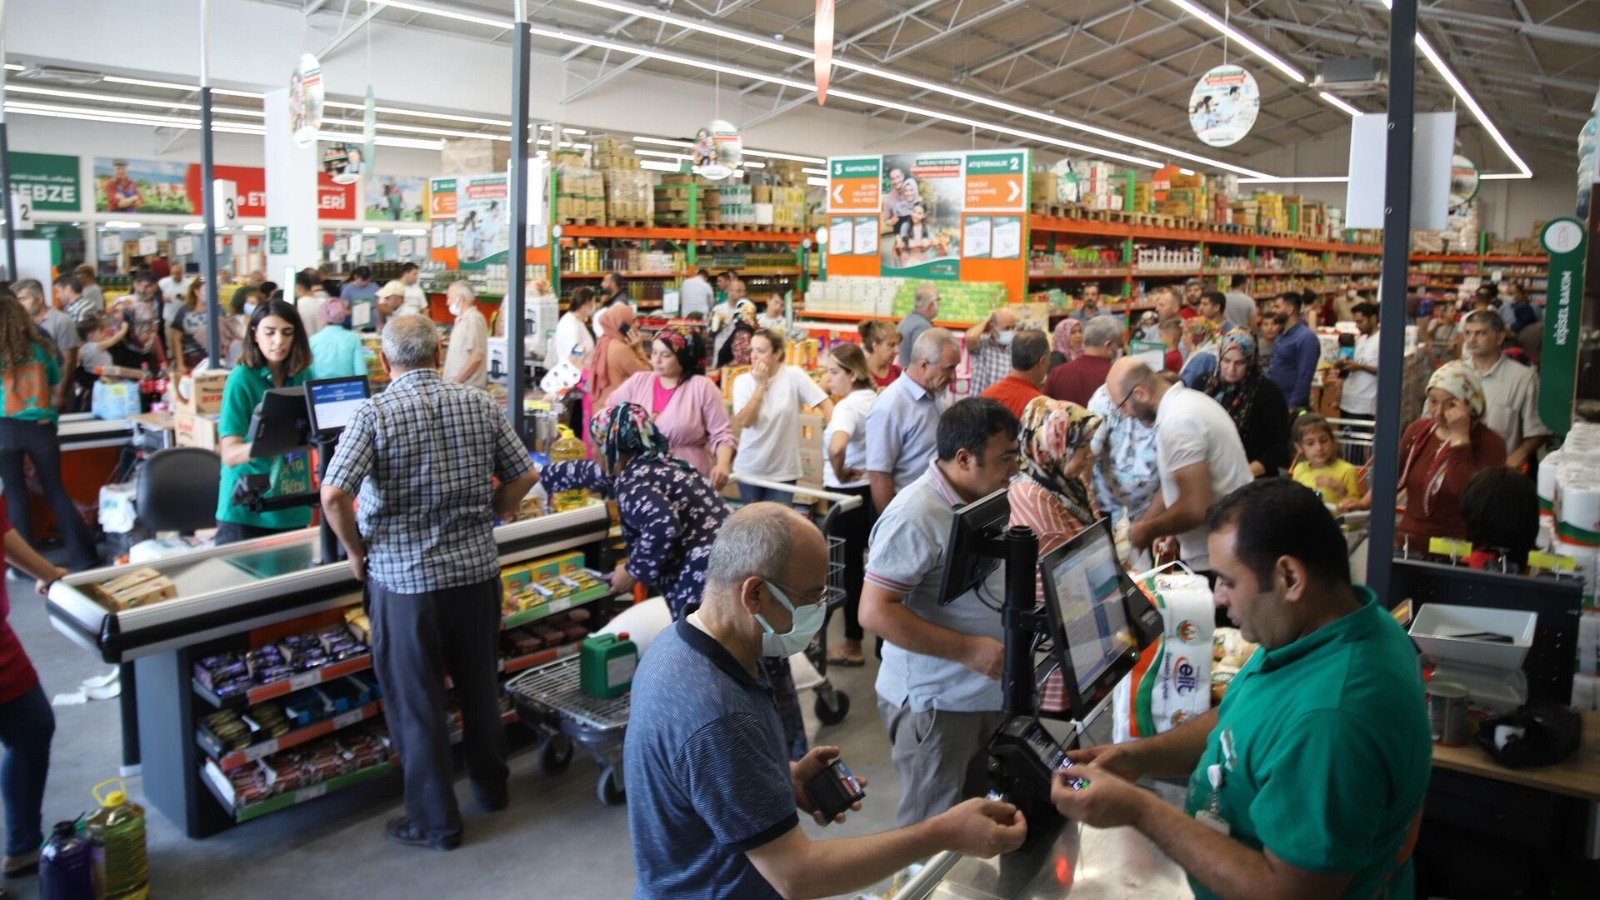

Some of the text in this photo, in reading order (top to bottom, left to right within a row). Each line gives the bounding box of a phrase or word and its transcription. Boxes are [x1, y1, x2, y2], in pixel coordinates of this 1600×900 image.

[834, 163, 843, 175] 3
[1010, 157, 1020, 170] 2
[21, 203, 30, 221] 2
[225, 197, 236, 220] 3
[1559, 270, 1572, 306] BAKIM
[1177, 663, 1196, 695] elit
